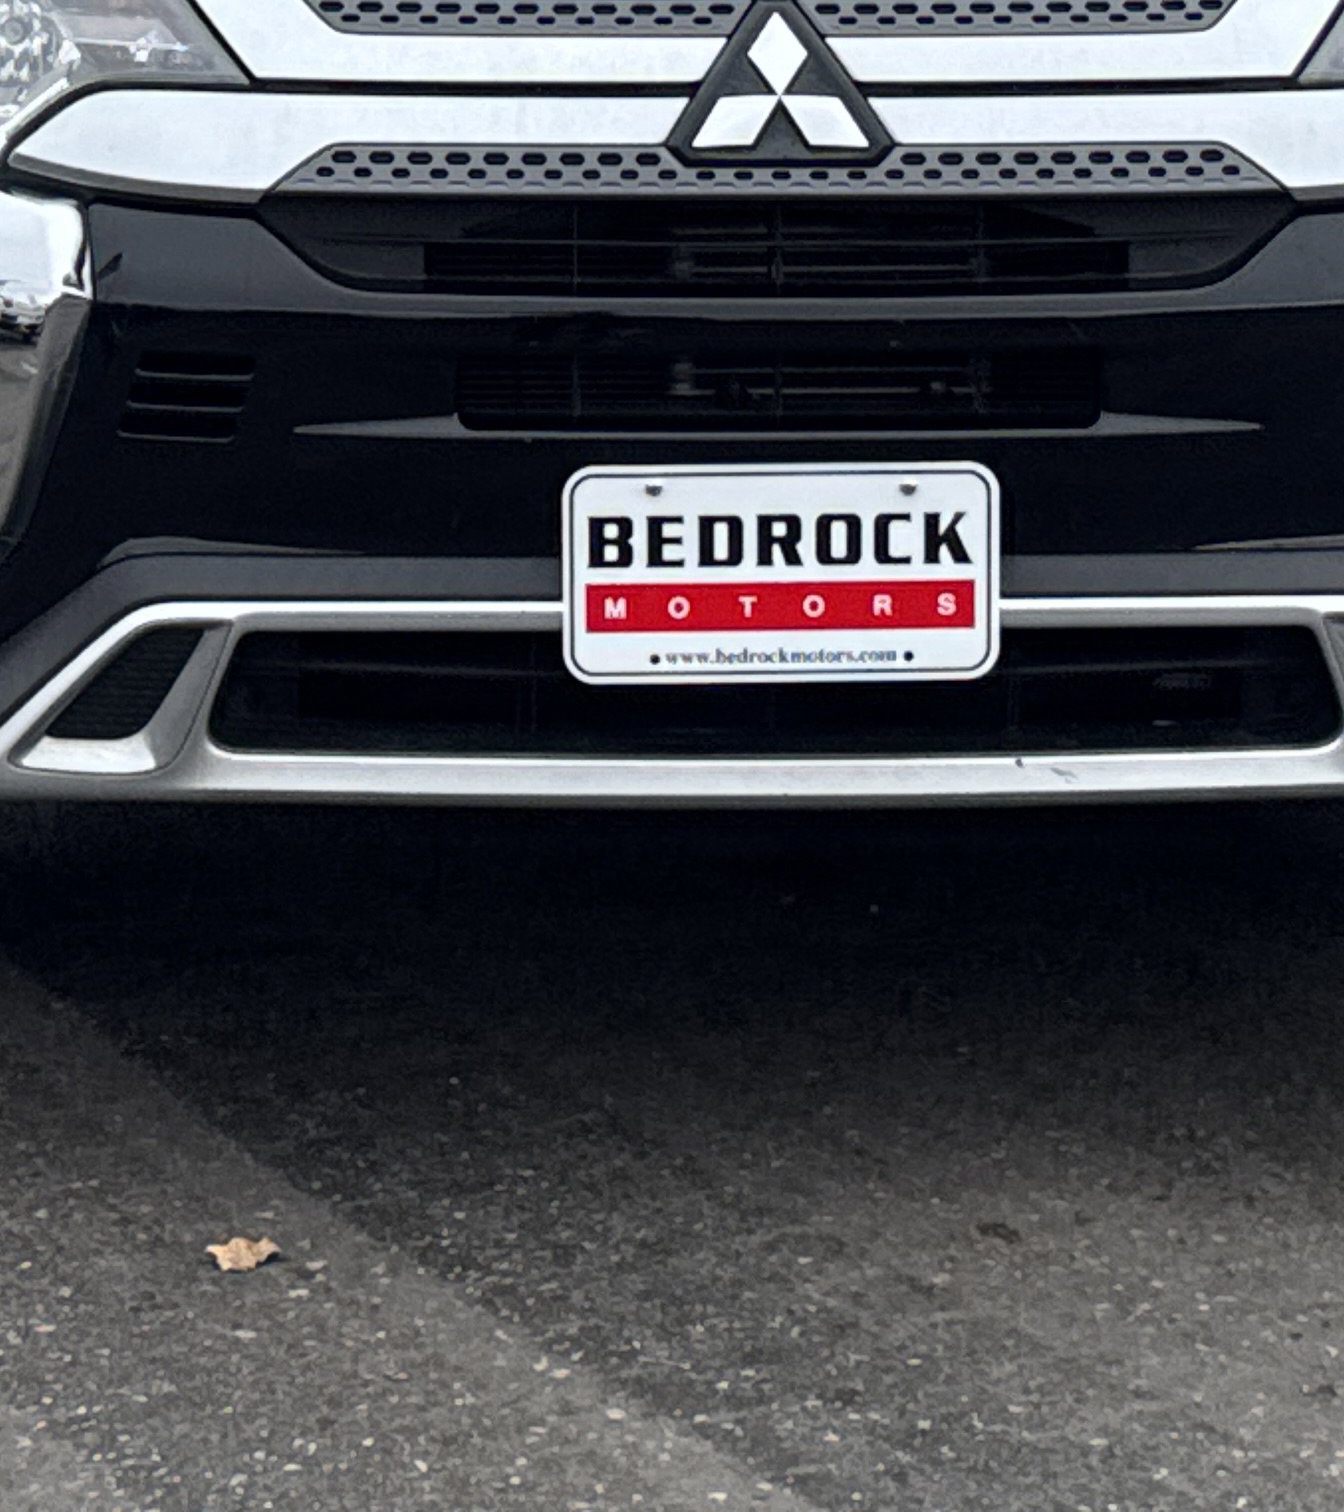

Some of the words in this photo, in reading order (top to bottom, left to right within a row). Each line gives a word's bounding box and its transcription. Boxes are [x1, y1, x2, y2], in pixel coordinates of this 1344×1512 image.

[587, 511, 974, 568] BEDROCK
[603, 592, 958, 621] MOTORS
[665, 646, 898, 666] www.bedrockmotors.com
